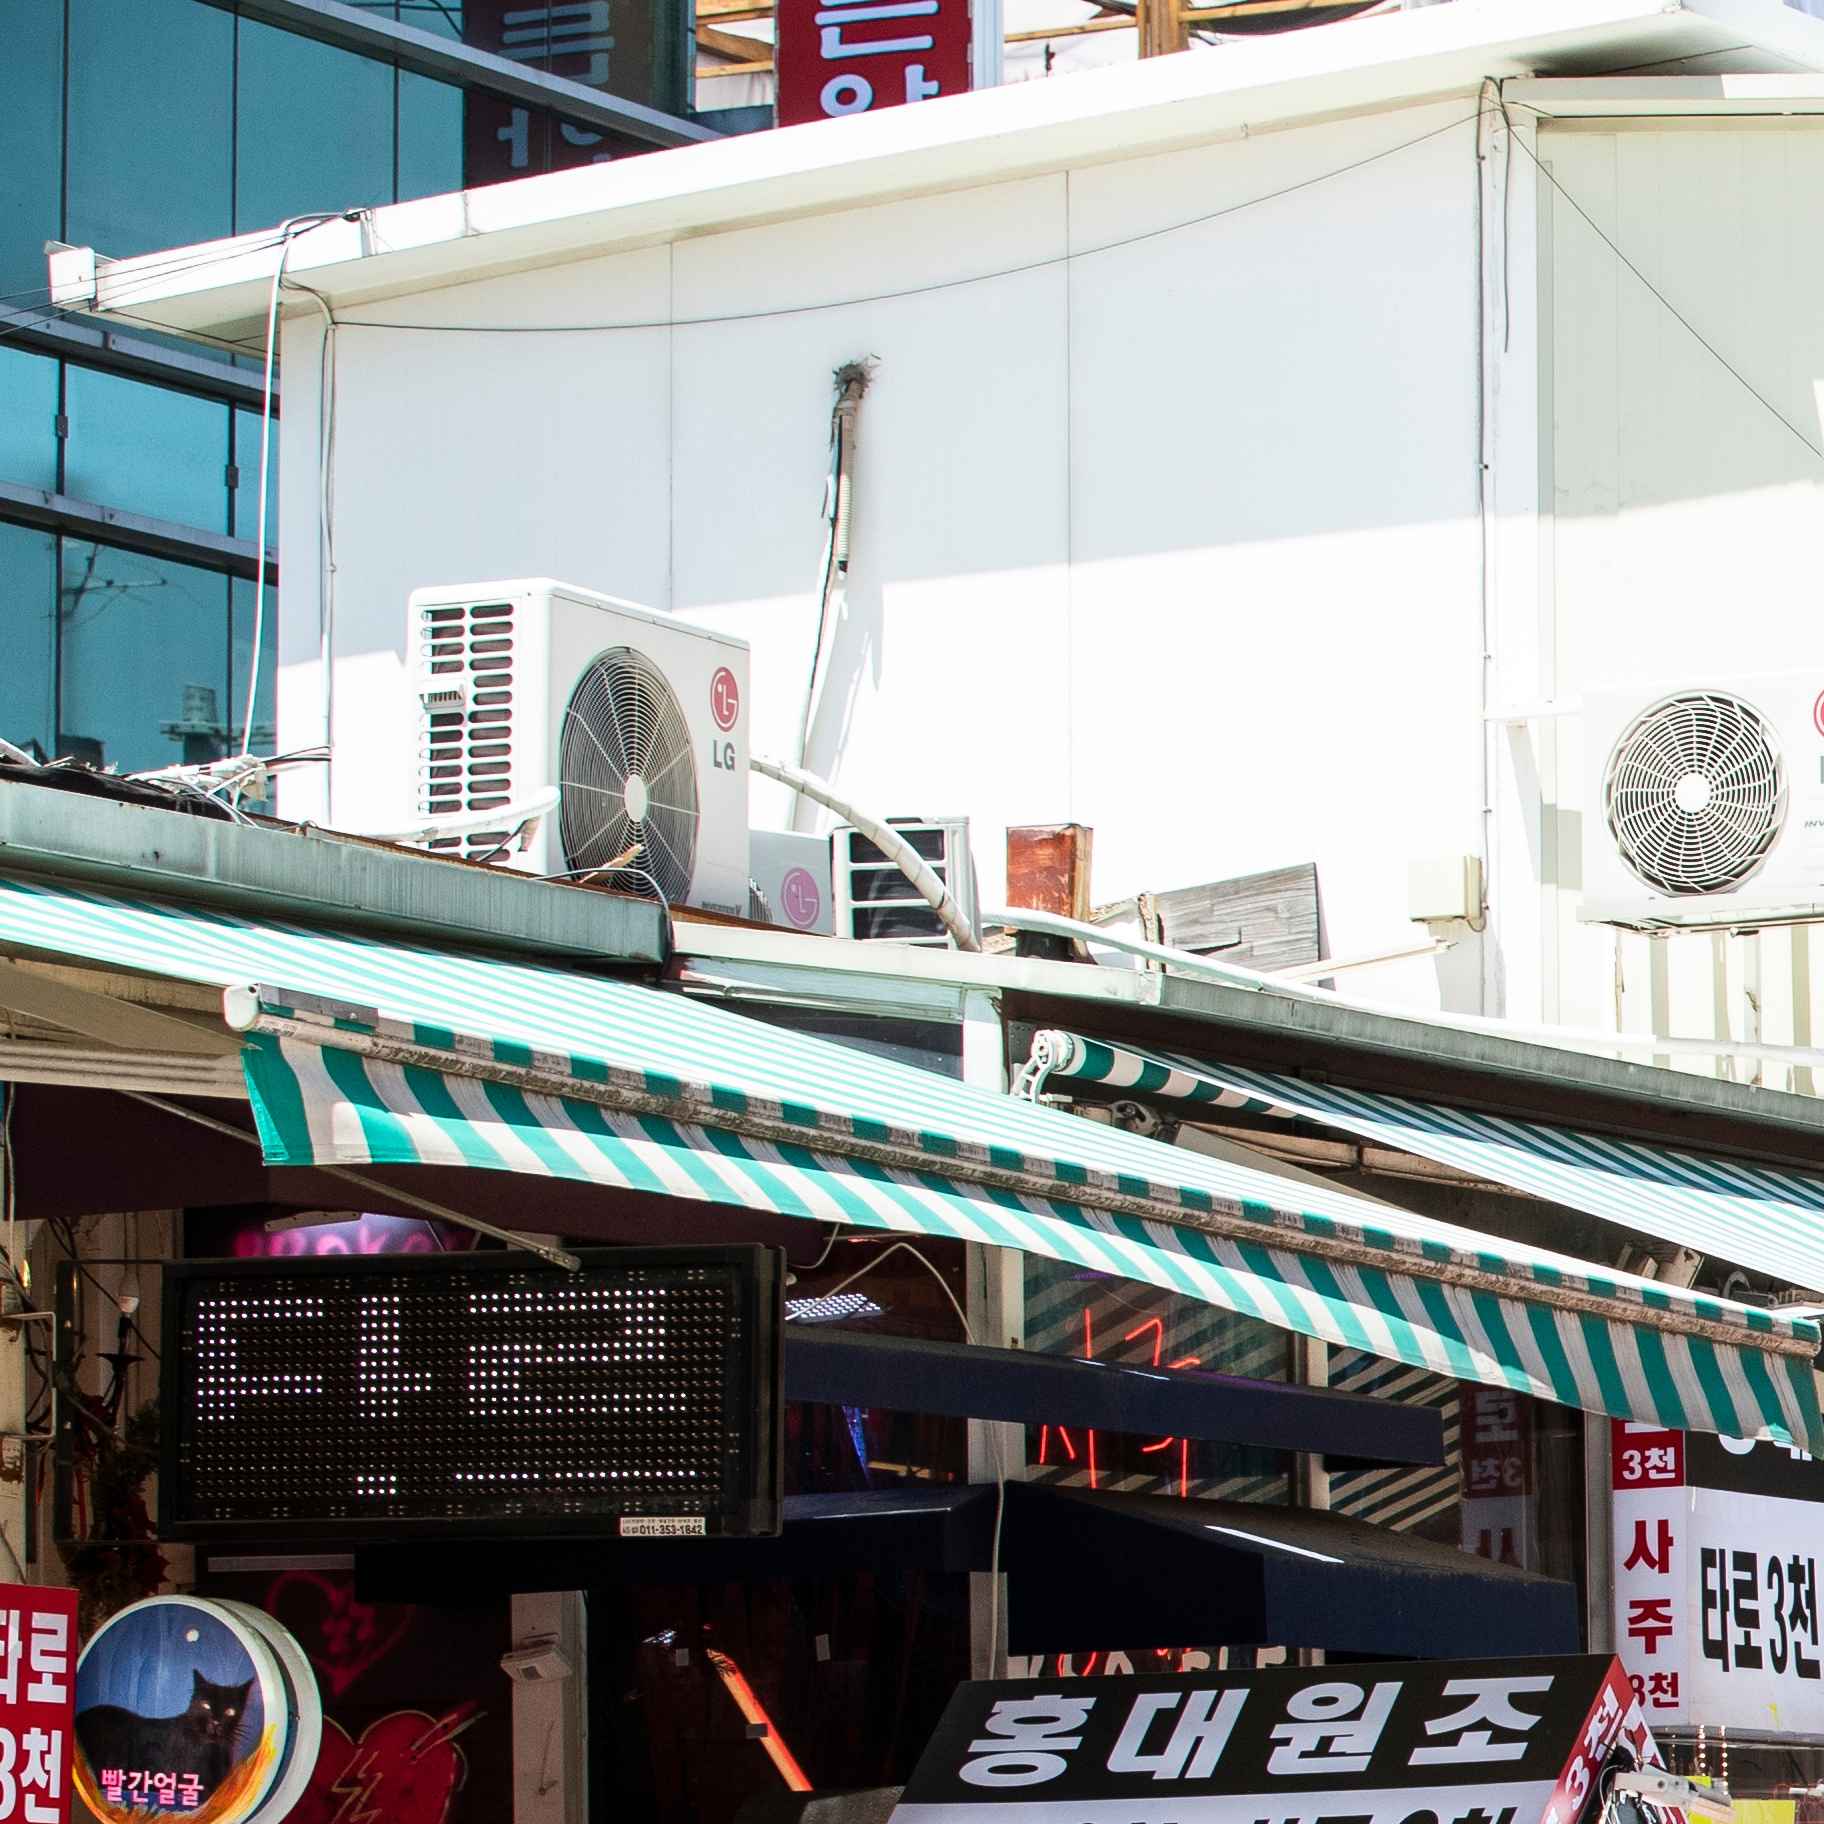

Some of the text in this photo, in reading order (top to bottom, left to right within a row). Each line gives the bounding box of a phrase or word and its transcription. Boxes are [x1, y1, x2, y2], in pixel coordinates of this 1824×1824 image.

[712, 739, 737, 772] LG
[1621, 1447, 1678, 1478] 3천
[1623, 1518, 1675, 1655] 사주
[956, 1674, 1557, 1788] 홍대원조
[101, 1769, 205, 1807] 빨간얼굴
